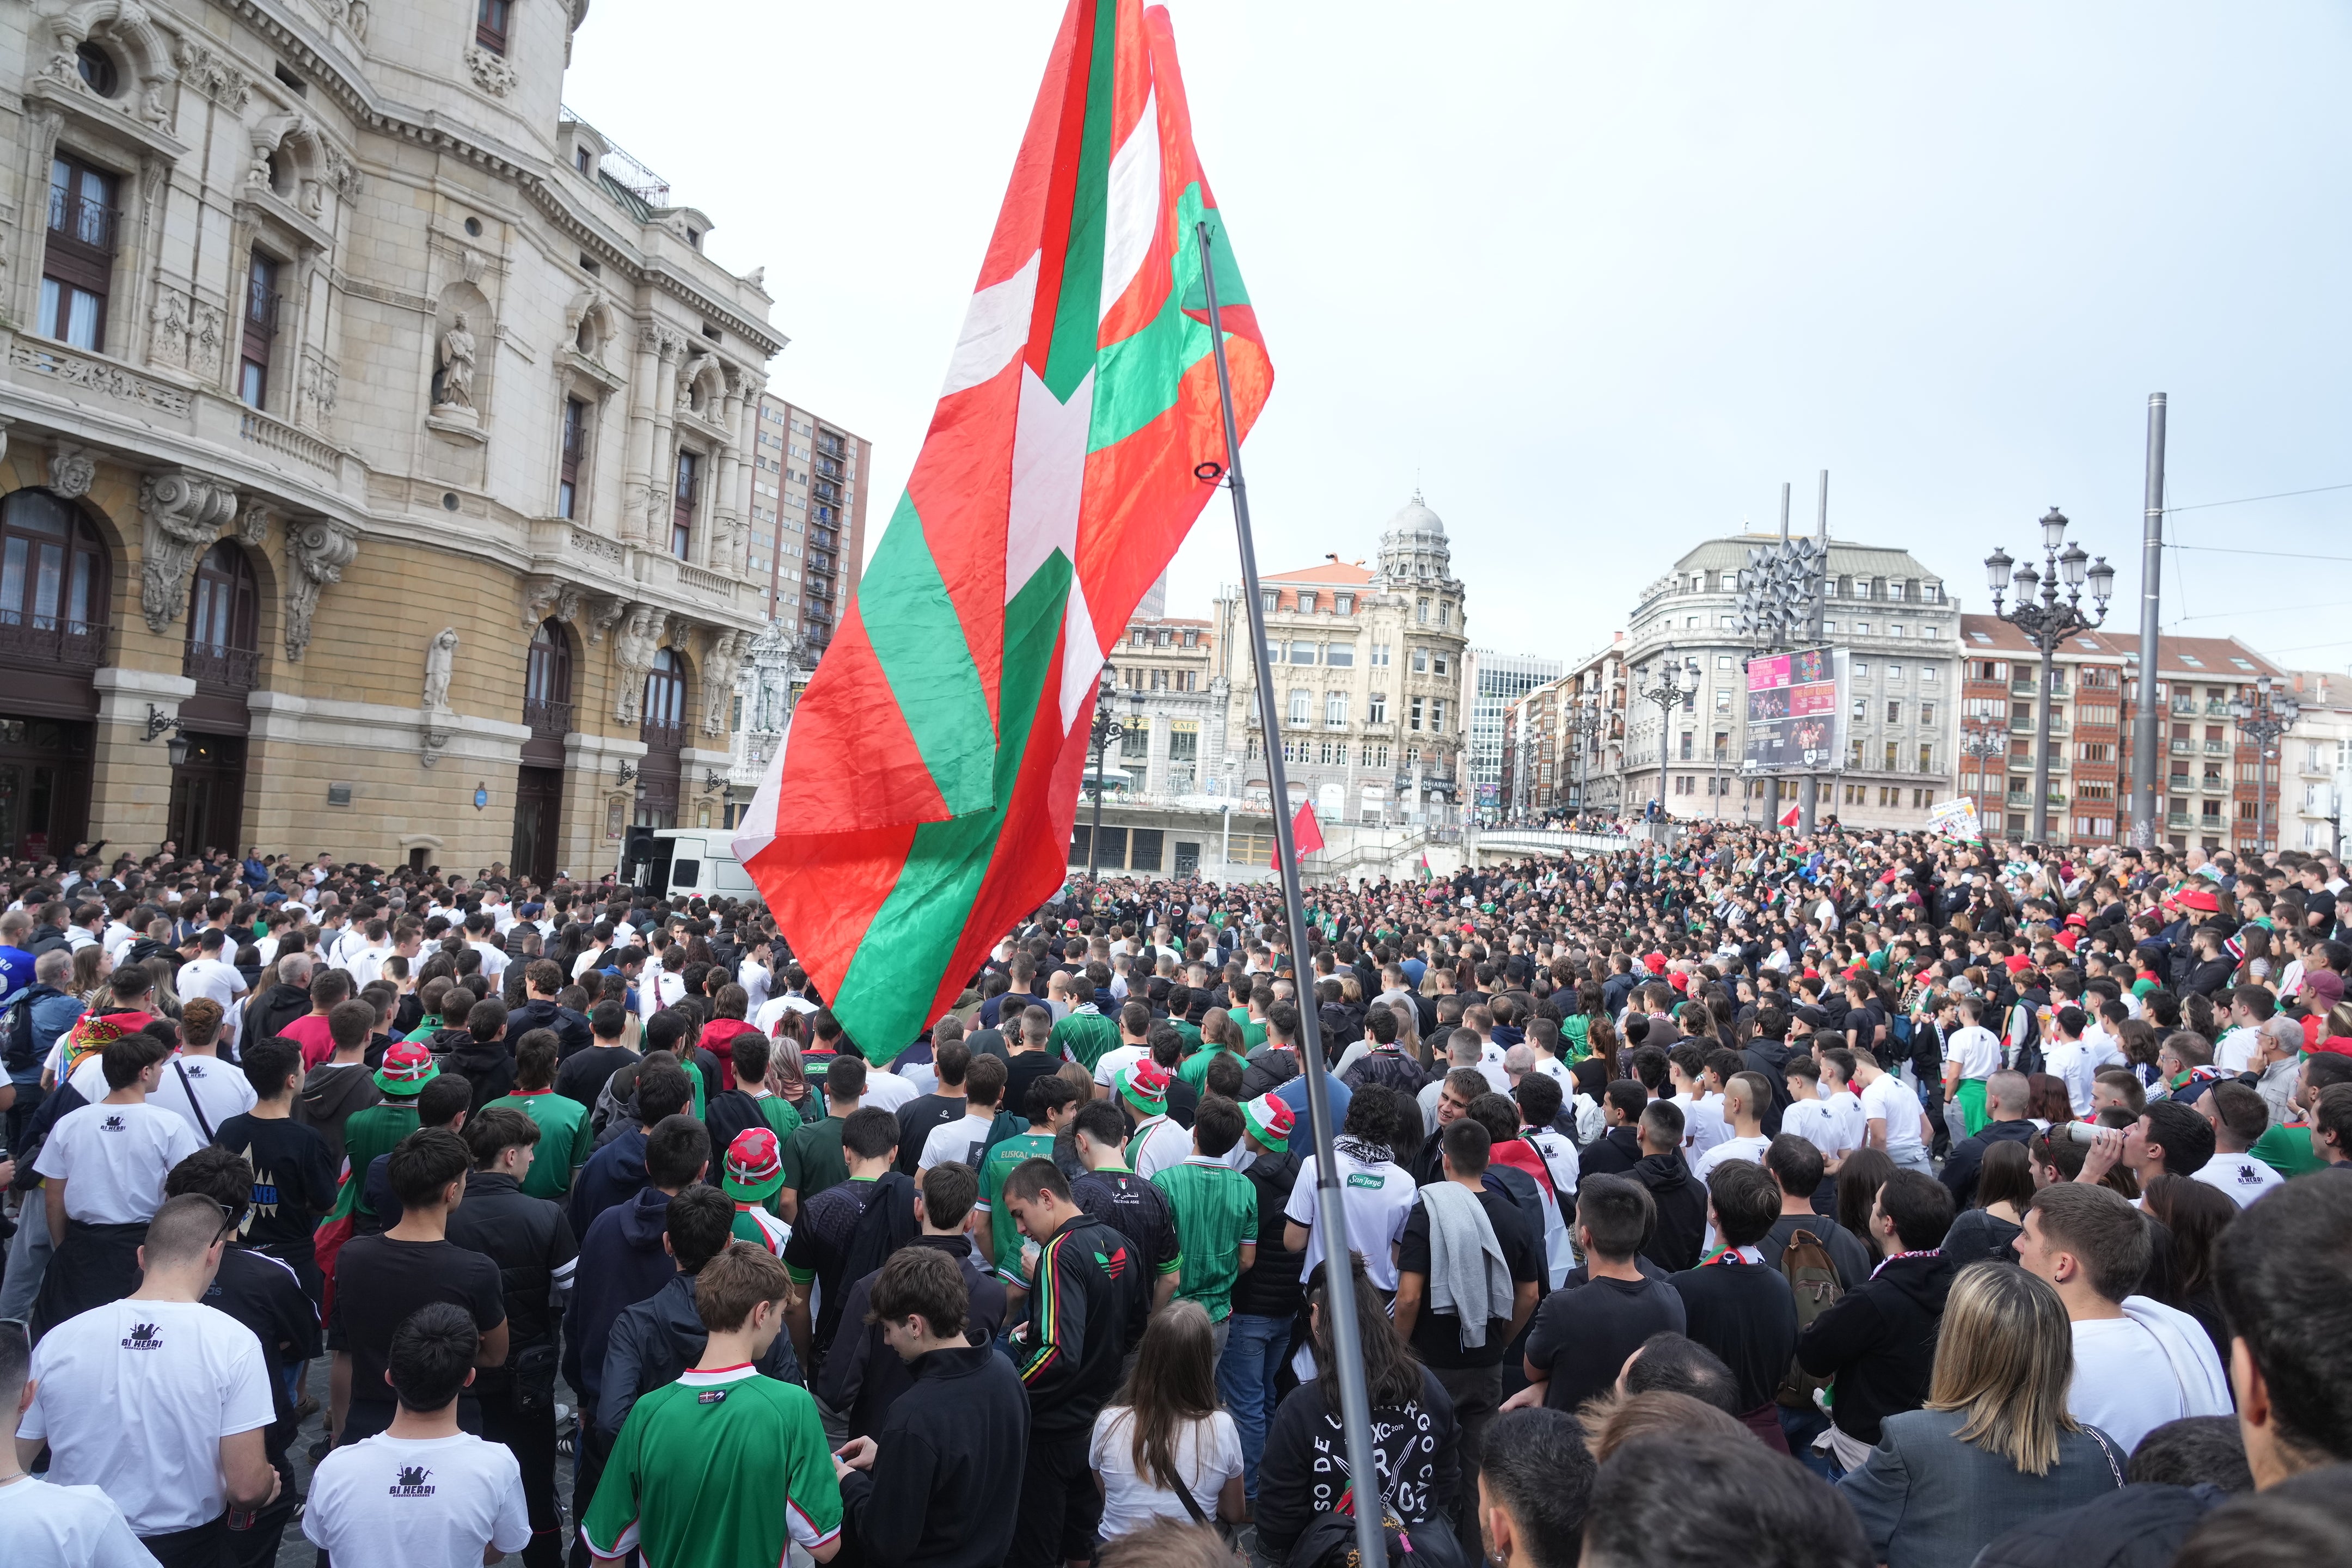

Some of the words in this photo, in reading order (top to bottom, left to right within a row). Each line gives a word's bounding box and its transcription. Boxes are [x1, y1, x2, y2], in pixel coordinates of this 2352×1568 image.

[1172, 722, 1196, 730] CAFE
[1001, 1150, 1028, 1160] EUSKAL
[1349, 1175, 1363, 1184] San
[1363, 1177, 1382, 1187] Jorge
[121, 1338, 132, 1346] BI
[133, 1340, 163, 1349] HERRI
[1391, 1423, 1404, 1432] 2019
[389, 1485, 401, 1494] BI
[403, 1485, 436, 1494] HERRI
